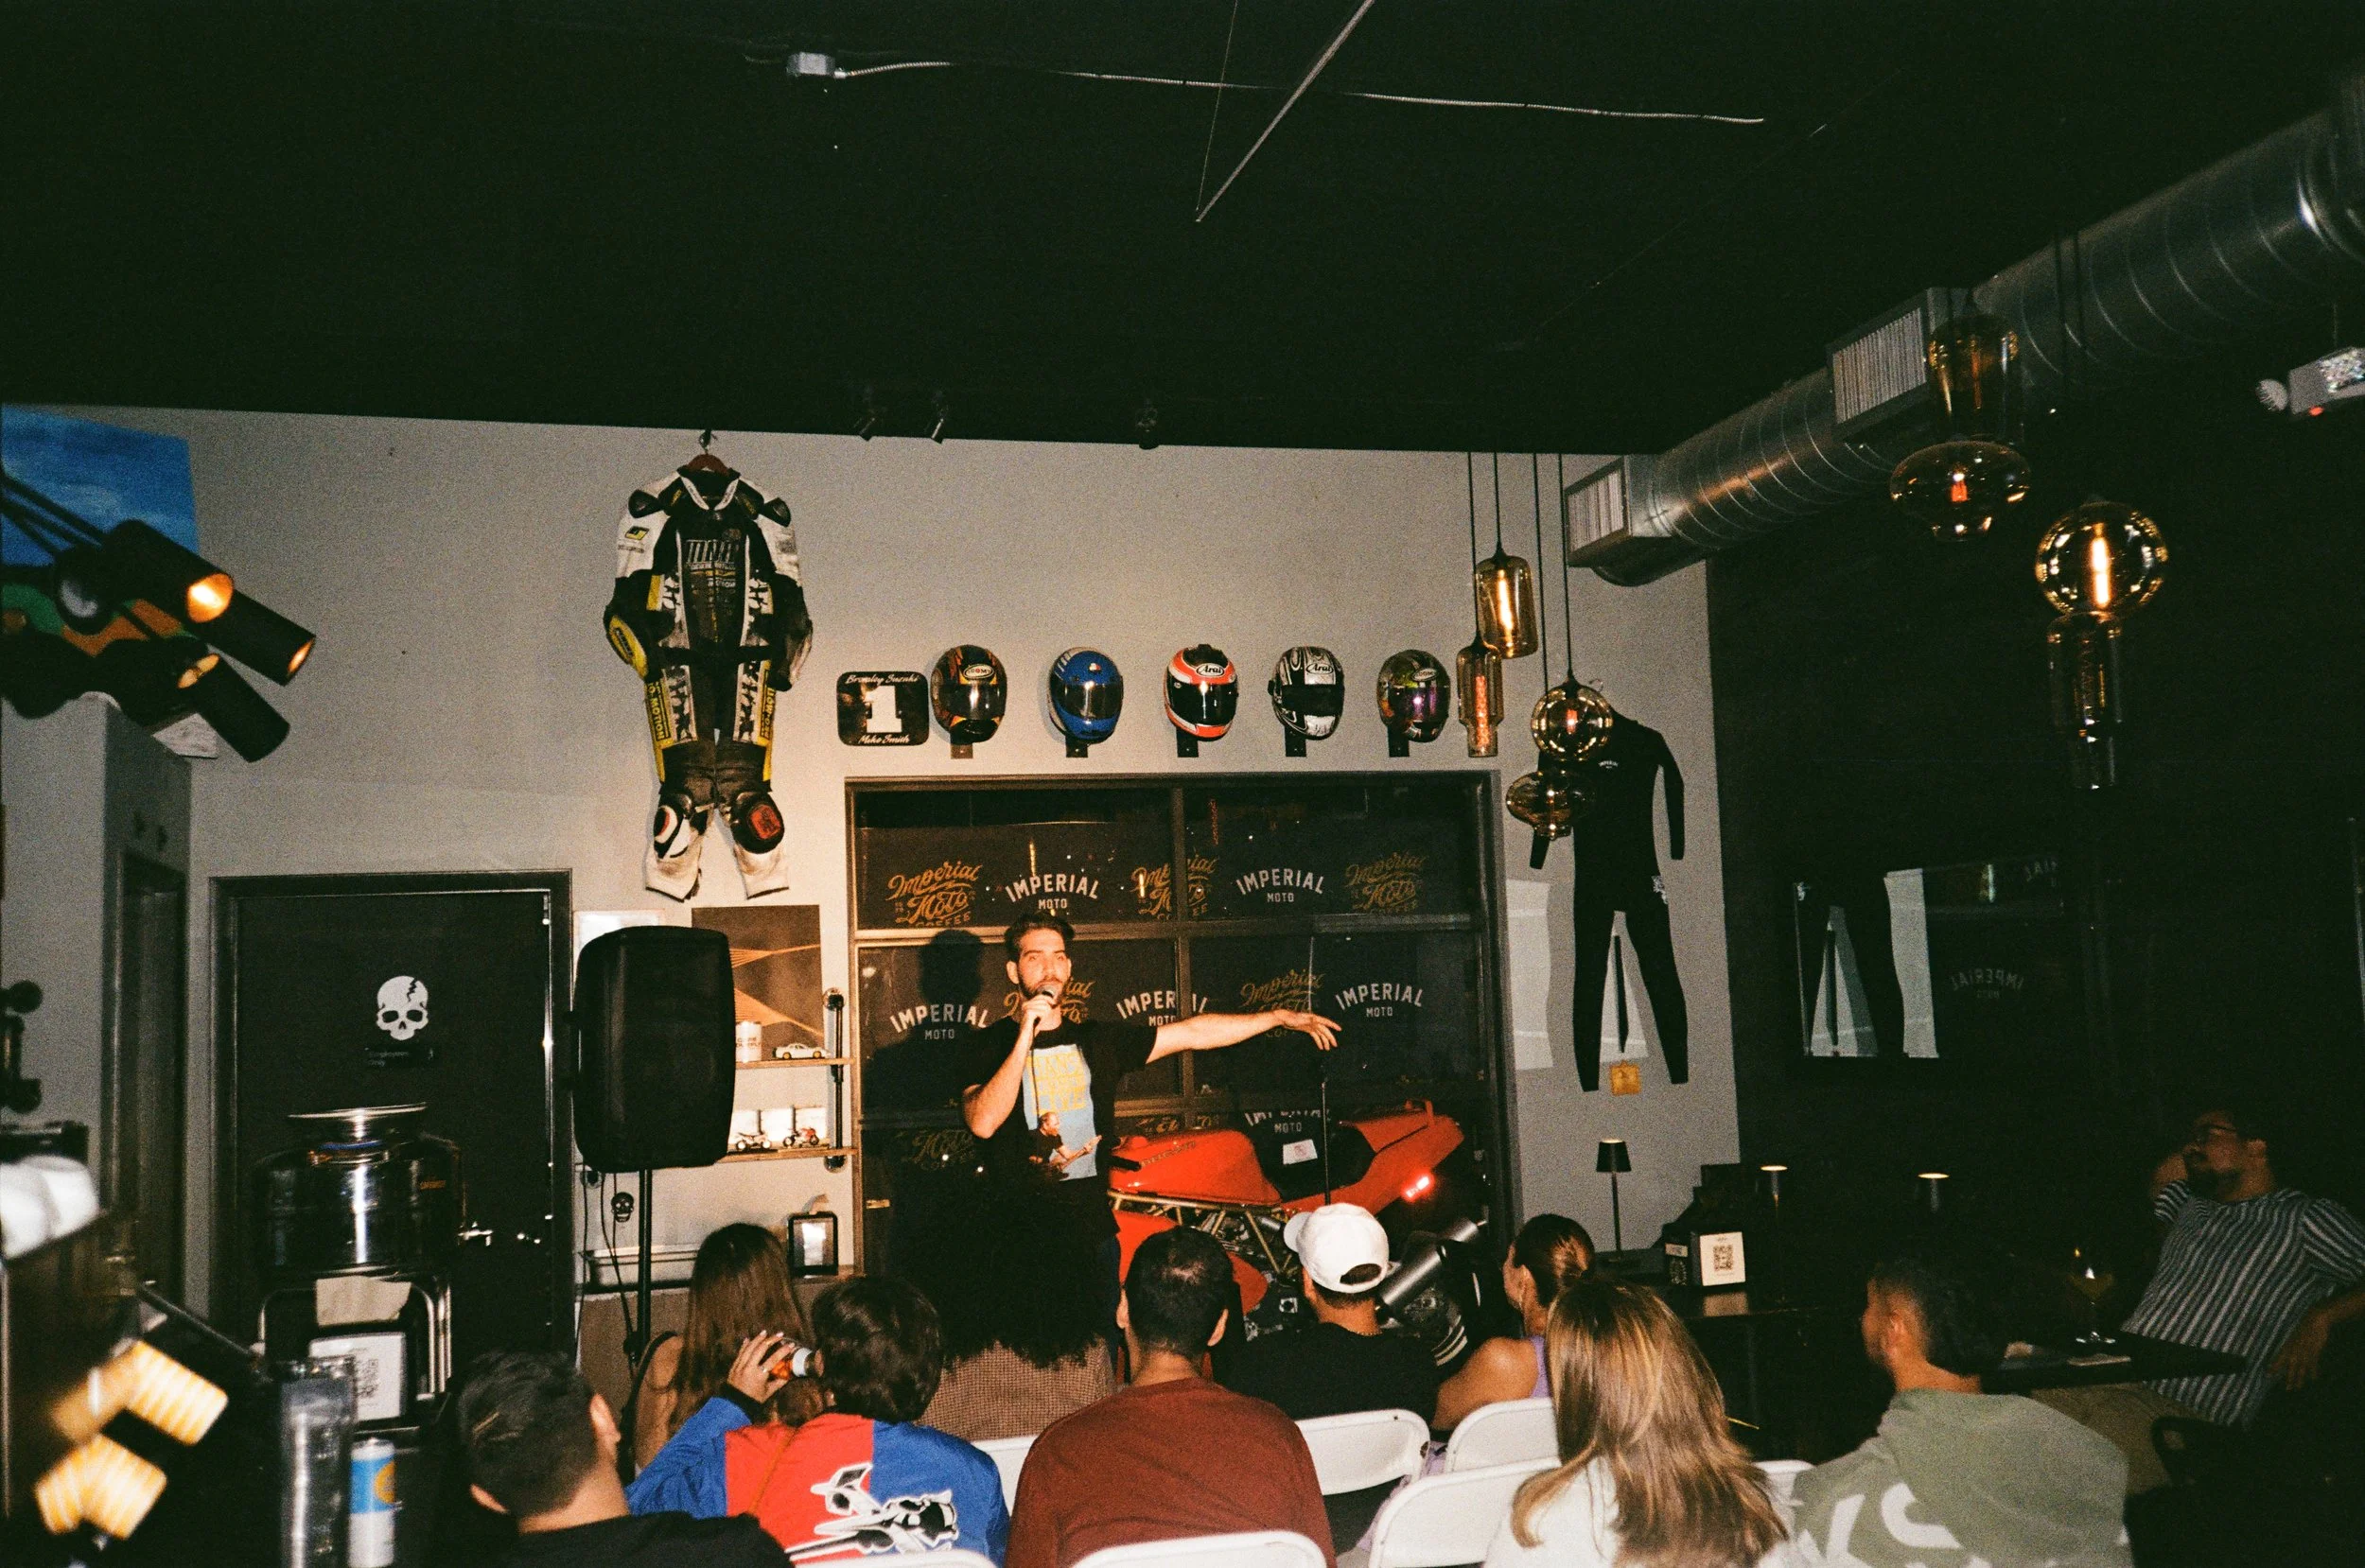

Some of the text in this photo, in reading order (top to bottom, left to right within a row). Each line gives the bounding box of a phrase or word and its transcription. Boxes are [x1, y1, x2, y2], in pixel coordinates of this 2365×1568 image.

[1198, 665, 1221, 674] Arai
[1308, 663, 1332, 672] Arai
[863, 686, 902, 733] 1
[885, 861, 983, 900] Imperial
[1235, 868, 1324, 895] IMPERIAL
[1005, 873, 1098, 902] IMPERIAL
[1267, 892, 1294, 902] MOTO
[1038, 898, 1068, 910] MOTO
[1335, 983, 1423, 1010] IMPERIAL
[1366, 1006, 1393, 1018] MOTO
[889, 1003, 989, 1034] IMPERIAL
[924, 1028, 955, 1040] MOTO
[1274, 1121, 1303, 1133] MOTO
